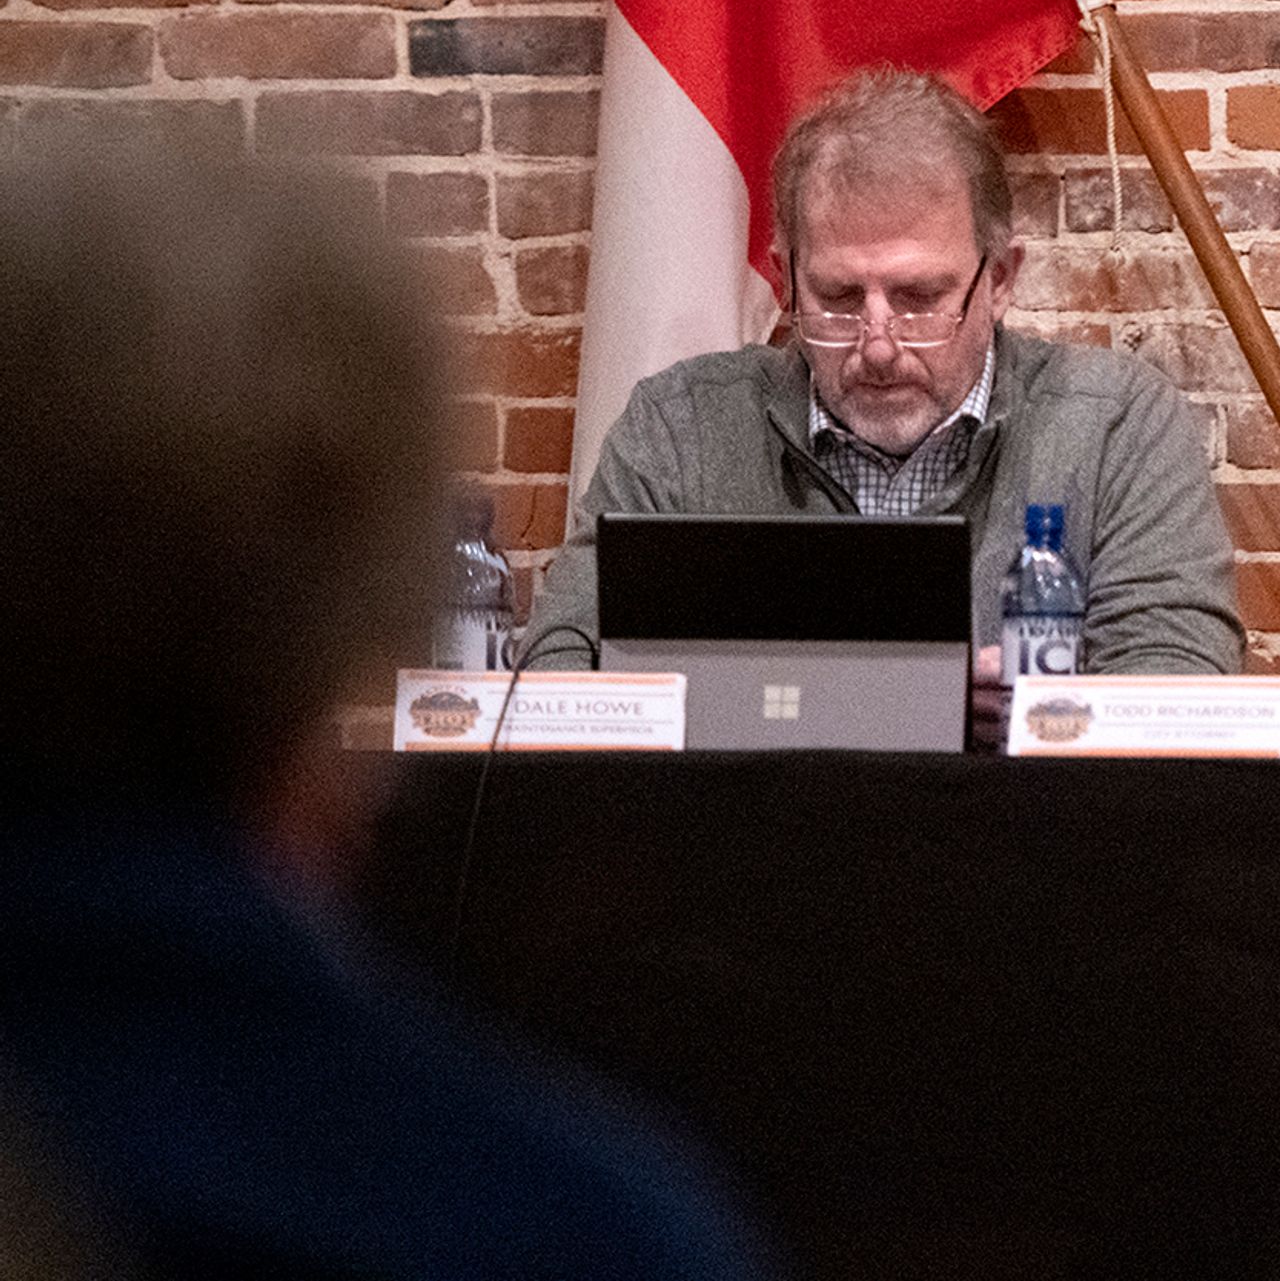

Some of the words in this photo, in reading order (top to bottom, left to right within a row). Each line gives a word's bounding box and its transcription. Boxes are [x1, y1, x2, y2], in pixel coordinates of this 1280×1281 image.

[514, 700, 567, 716] DALE
[575, 701, 644, 717] HOWE
[1103, 704, 1152, 718] TODD
[1156, 705, 1276, 719] RICHARDSON
